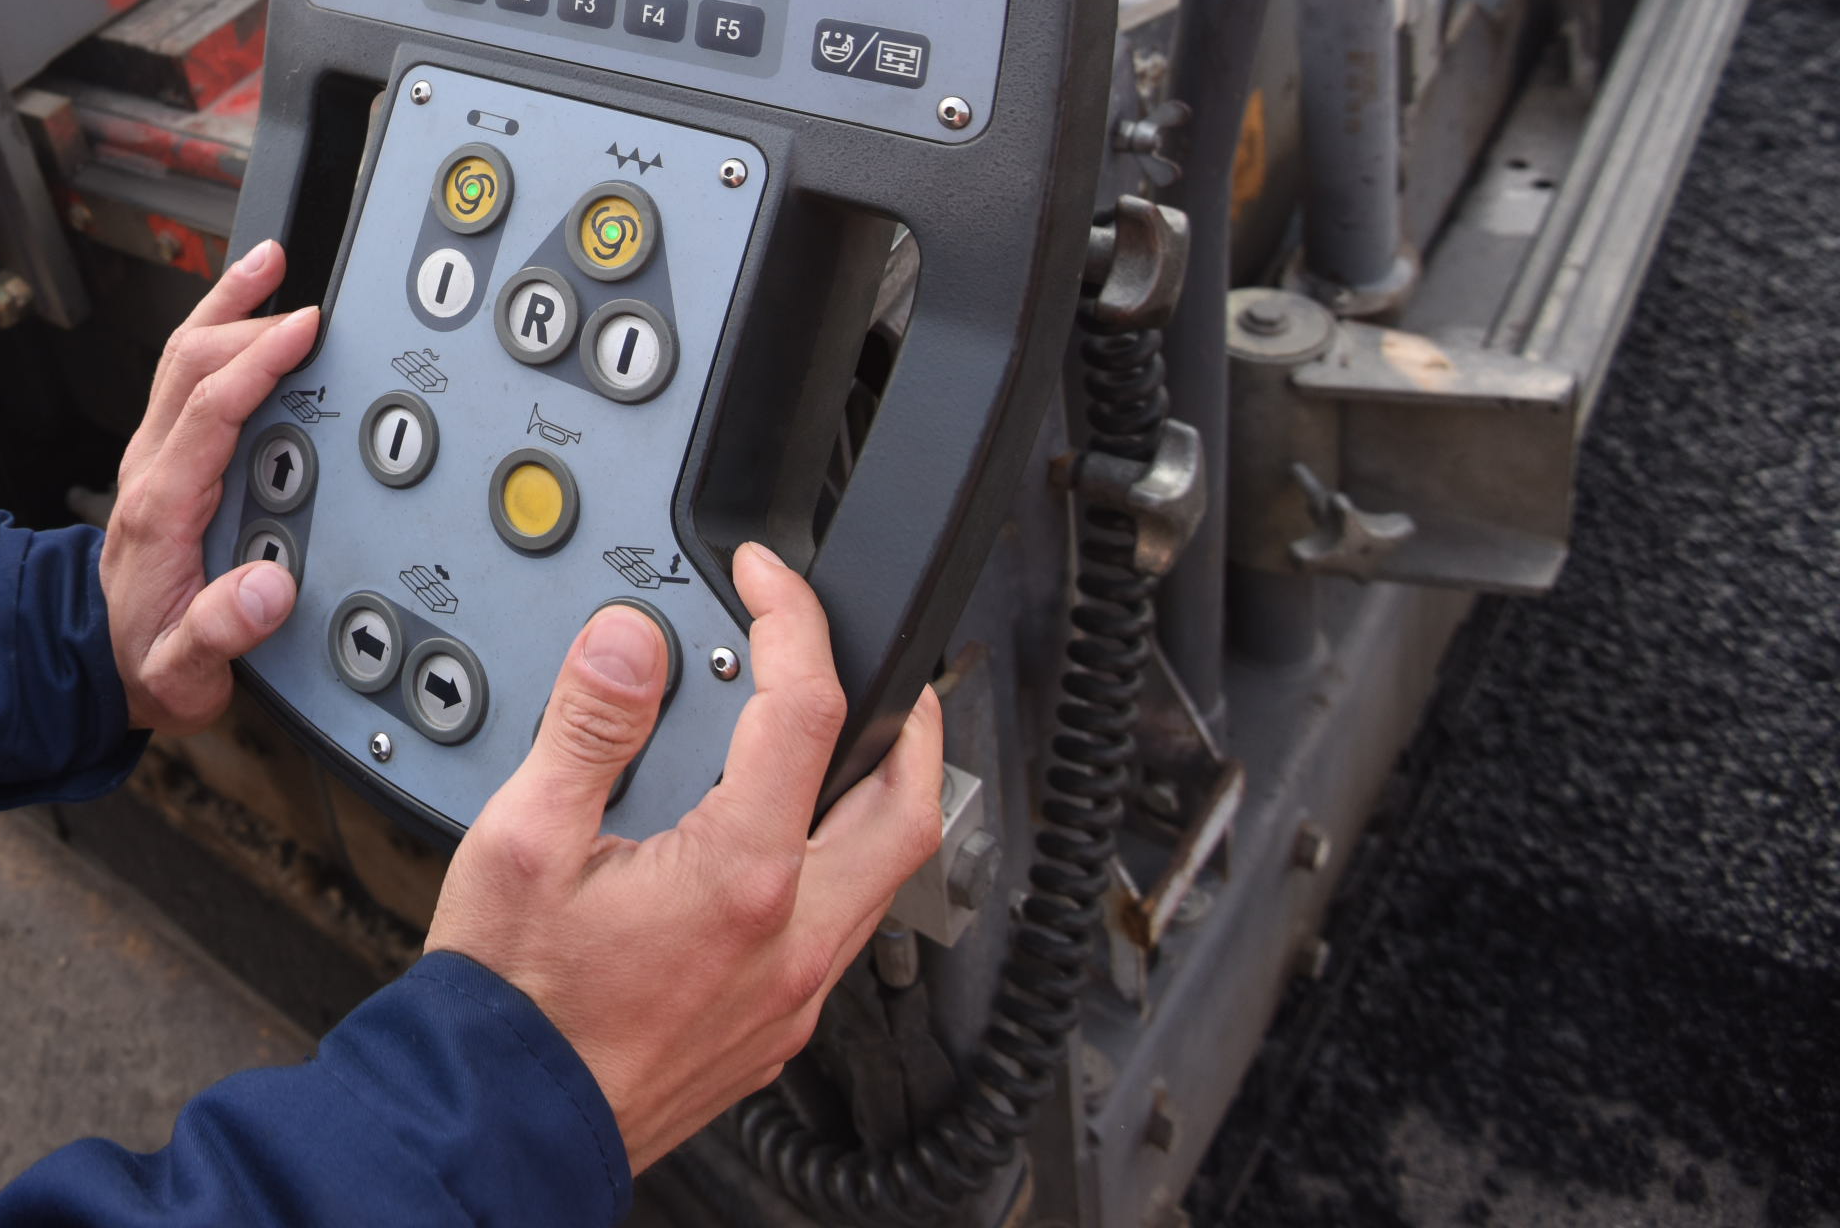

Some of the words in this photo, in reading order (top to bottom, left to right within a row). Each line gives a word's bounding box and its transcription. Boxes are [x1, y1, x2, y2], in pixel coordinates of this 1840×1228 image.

[641, 4, 665, 27] F4
[715, 17, 741, 41] F5
[521, 292, 555, 345] R
